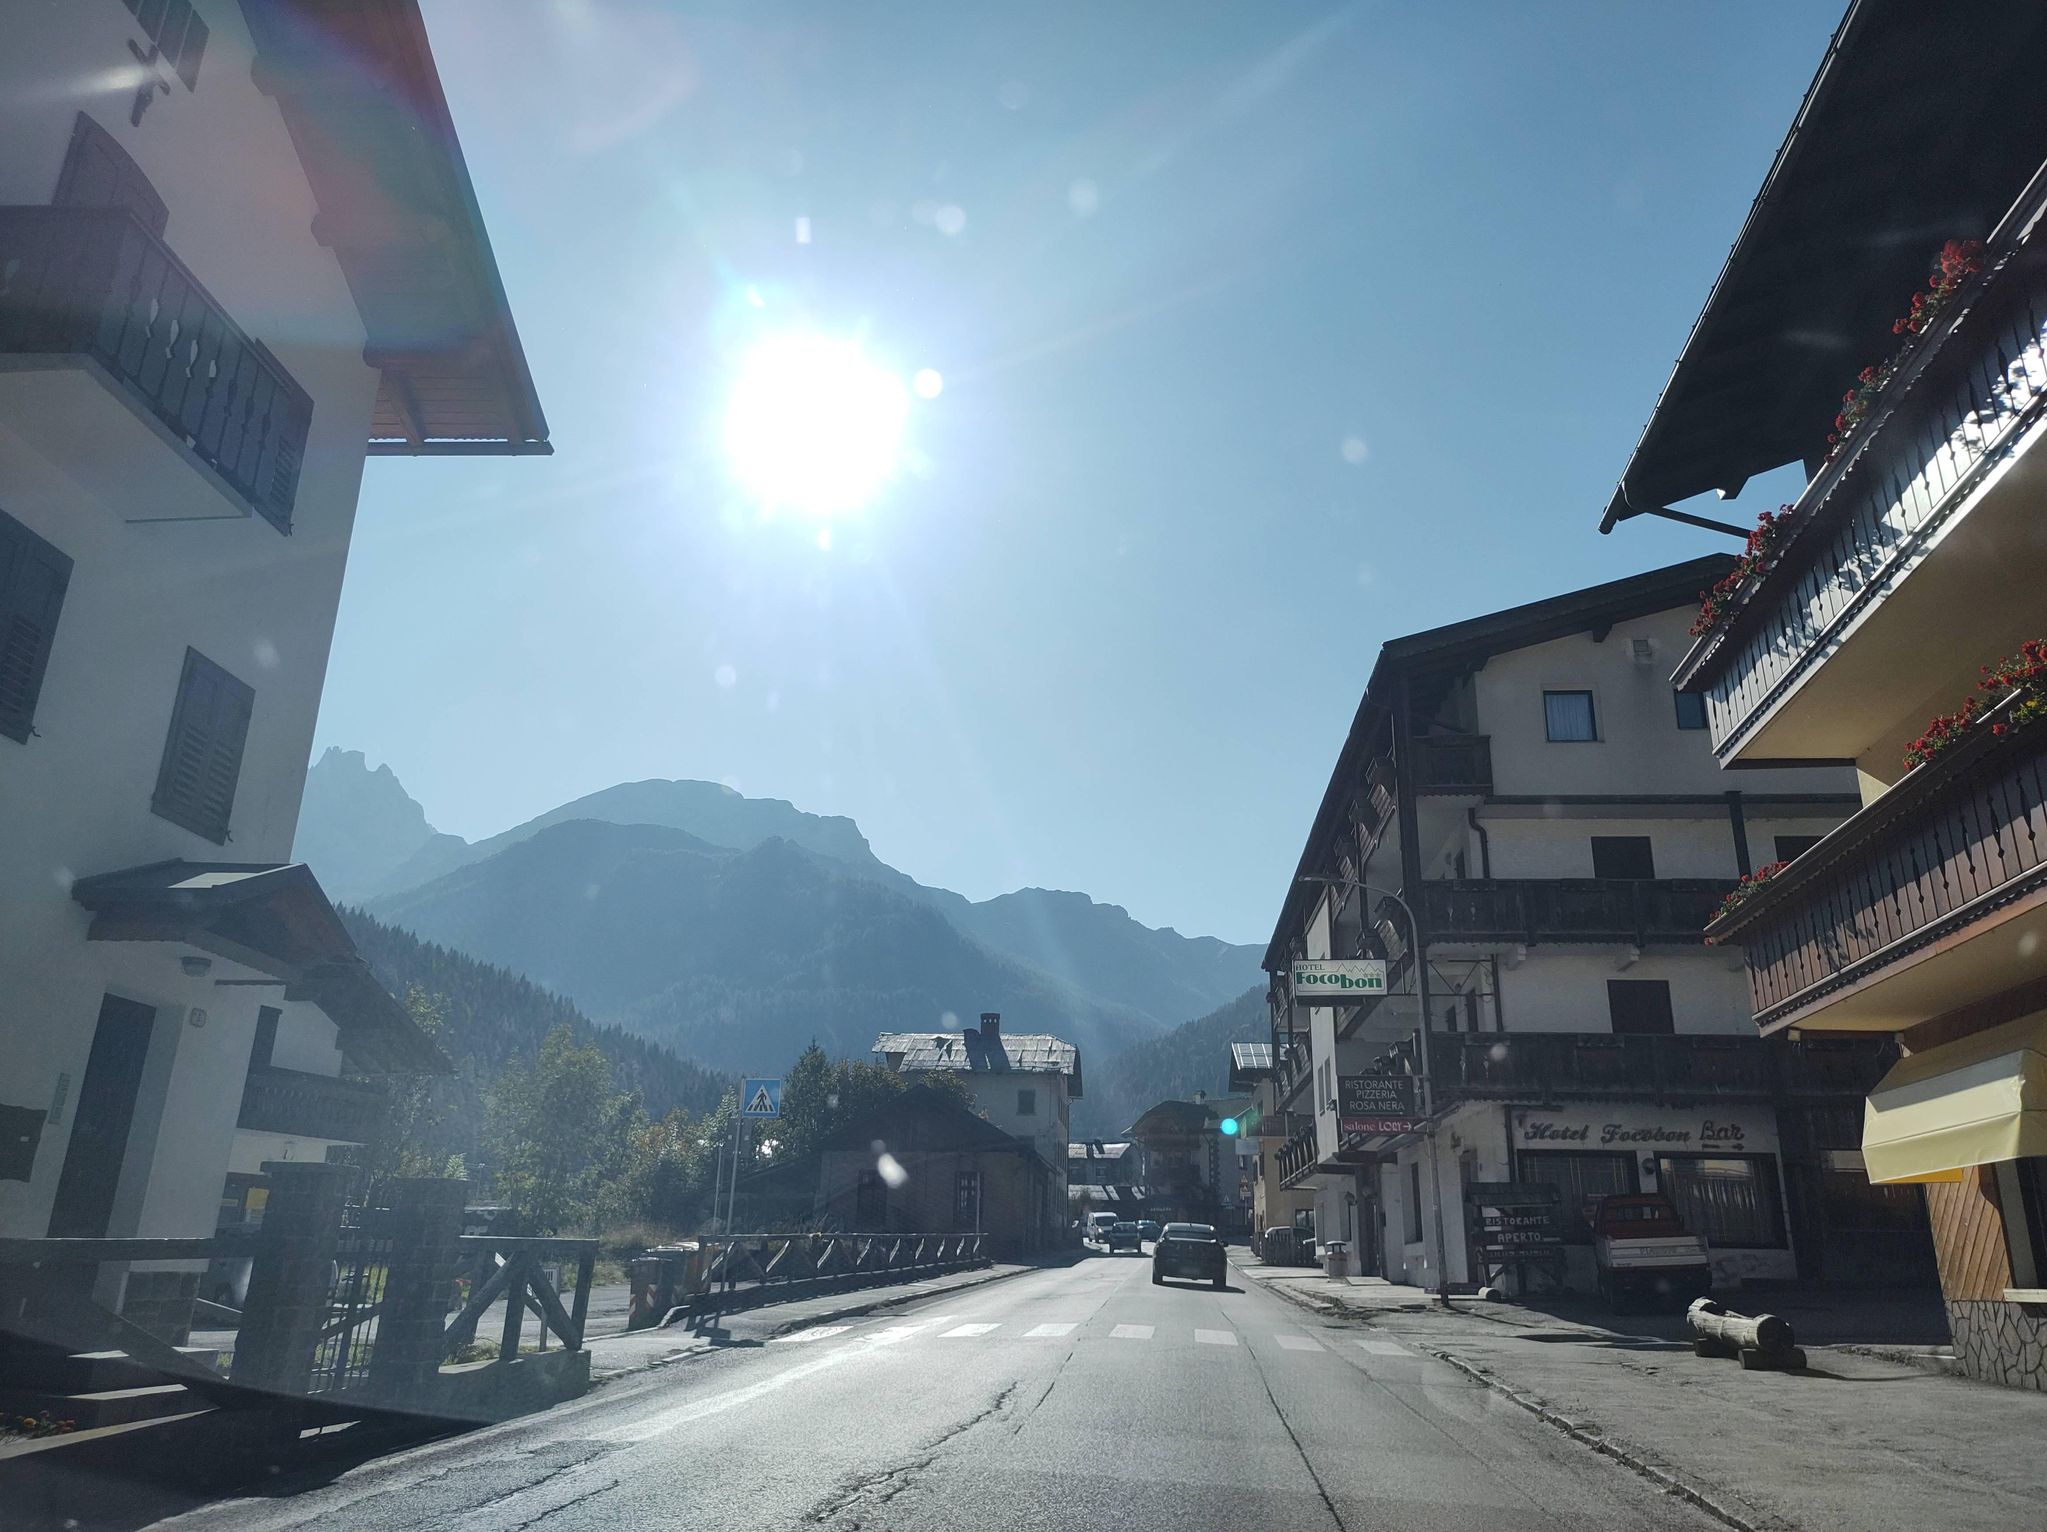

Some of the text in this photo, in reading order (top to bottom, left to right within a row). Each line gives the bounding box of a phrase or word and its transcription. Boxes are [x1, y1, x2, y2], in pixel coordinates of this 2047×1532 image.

[1296, 972, 1382, 988] Focobon
[1344, 1080, 1404, 1089] RISTORANTE
[1356, 1090, 1397, 1099] PIZZERIA
[1349, 1101, 1405, 1110] ROSA NERA
[1344, 1121, 1376, 1131] salone
[1524, 1121, 1589, 1141] Hotel
[1700, 1120, 1745, 1141] Bar
[1497, 1232, 1541, 1243] APERTO
